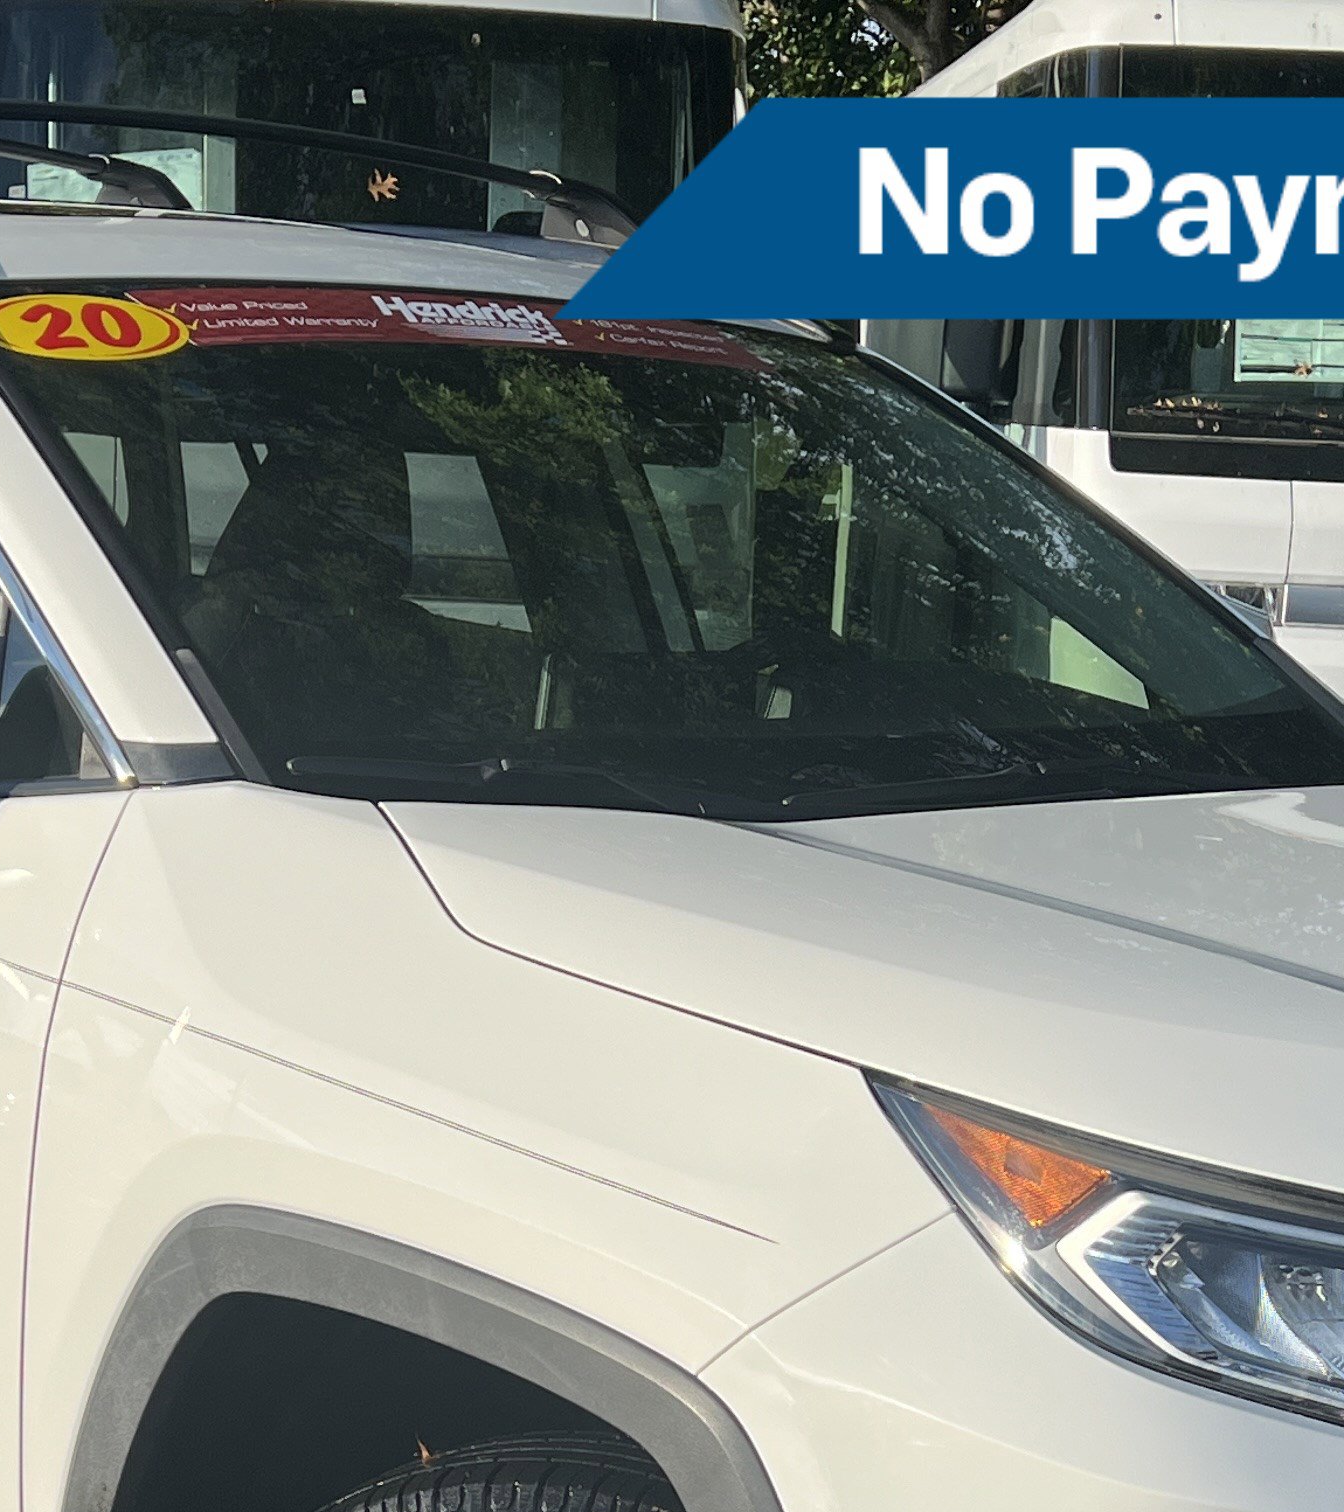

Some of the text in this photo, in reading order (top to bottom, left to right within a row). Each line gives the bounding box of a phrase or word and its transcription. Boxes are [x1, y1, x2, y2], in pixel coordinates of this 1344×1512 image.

[181, 301, 308, 312] Value Priced
[371, 295, 551, 326] Hendrick
[20, 303, 142, 350] 20
[203, 317, 379, 329] Limited Warranty
